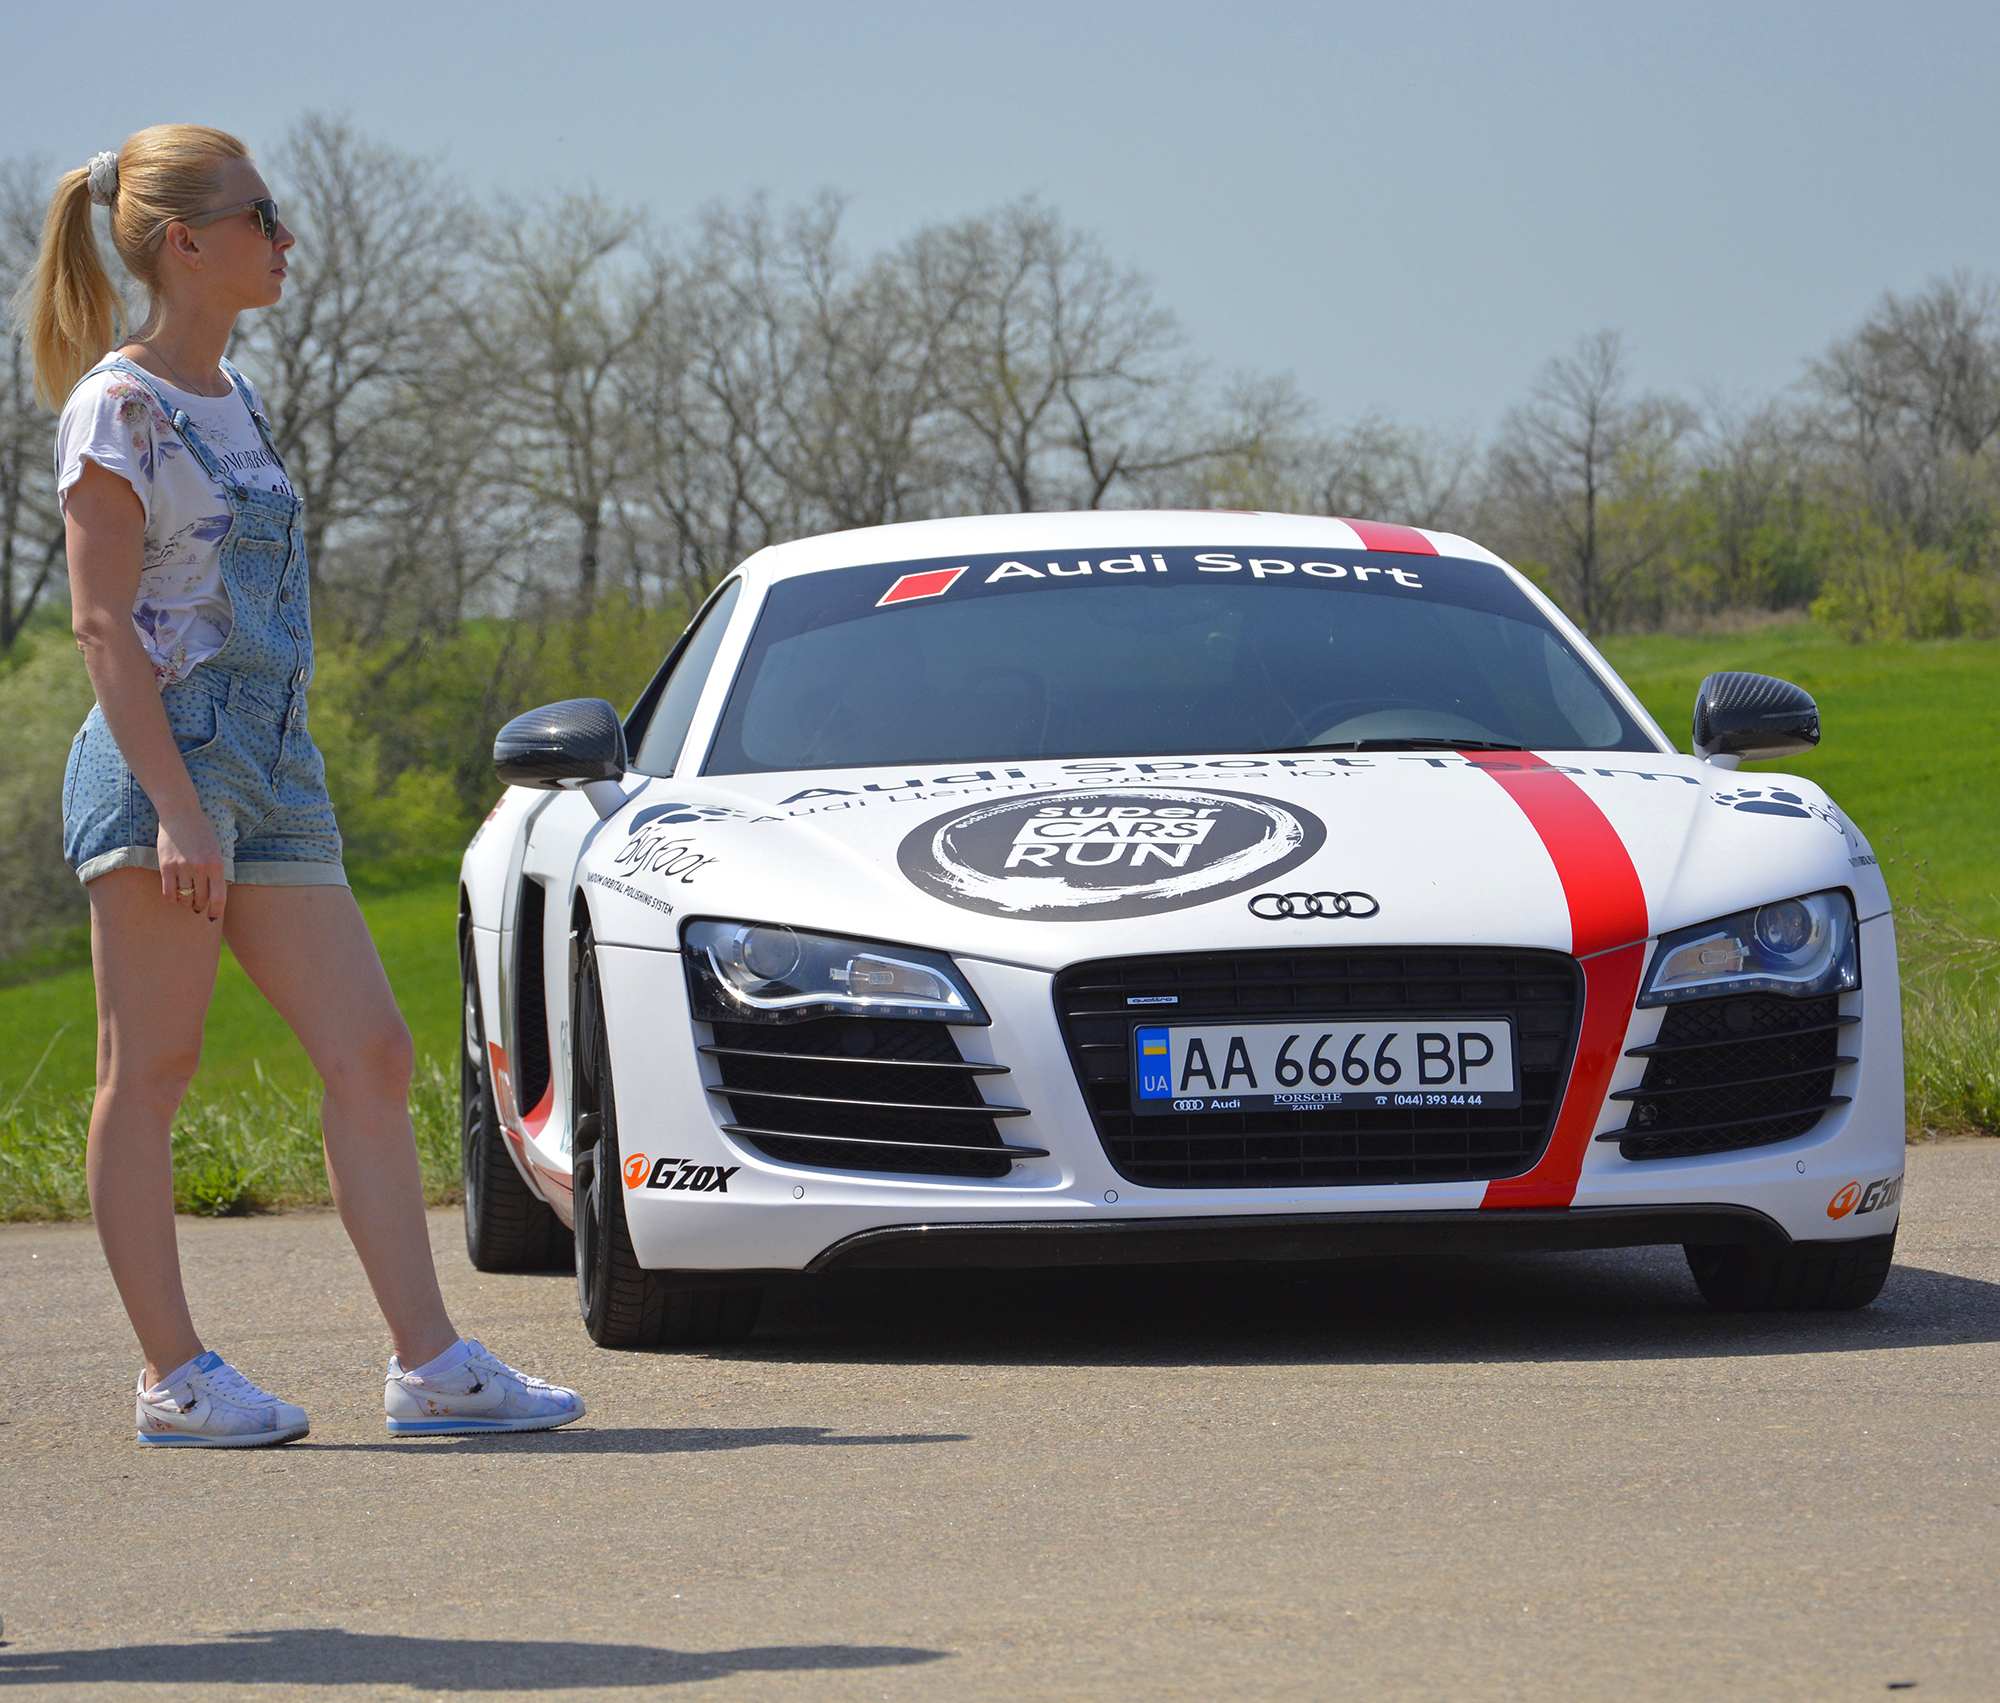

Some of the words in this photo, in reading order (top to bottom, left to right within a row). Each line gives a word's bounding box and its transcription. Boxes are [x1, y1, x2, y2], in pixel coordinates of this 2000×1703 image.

[984, 553, 1169, 584] Audi
[1193, 553, 1423, 588] Sport
[776, 768, 1026, 806] Audi
[1060, 758, 1376, 775] Sport
[1398, 757, 1701, 786] Team
[748, 799, 866, 823] Audi
[889, 781, 1057, 803] Центр
[1077, 772, 1268, 785] Одесса
[1034, 806, 1223, 819] super
[1033, 821, 1199, 838] CARS
[1003, 842, 1196, 868] RUN
[601, 876, 625, 894] ORBITAL
[623, 885, 653, 906] POLISHING
[650, 897, 674, 917] SYSTEM
[1179, 1036, 1258, 1091] AA
[1274, 1033, 1402, 1087] 6666
[1416, 1032, 1494, 1085] BP
[1144, 1075, 1169, 1092] UA
[1210, 1099, 1241, 1109] Audi
[1273, 1093, 1342, 1103] PORSCHE
[1394, 1094, 1423, 1106] (044)
[1426, 1095, 1448, 1105] 393
[1450, 1095, 1465, 1105] 44
[1467, 1095, 1482, 1105] 44
